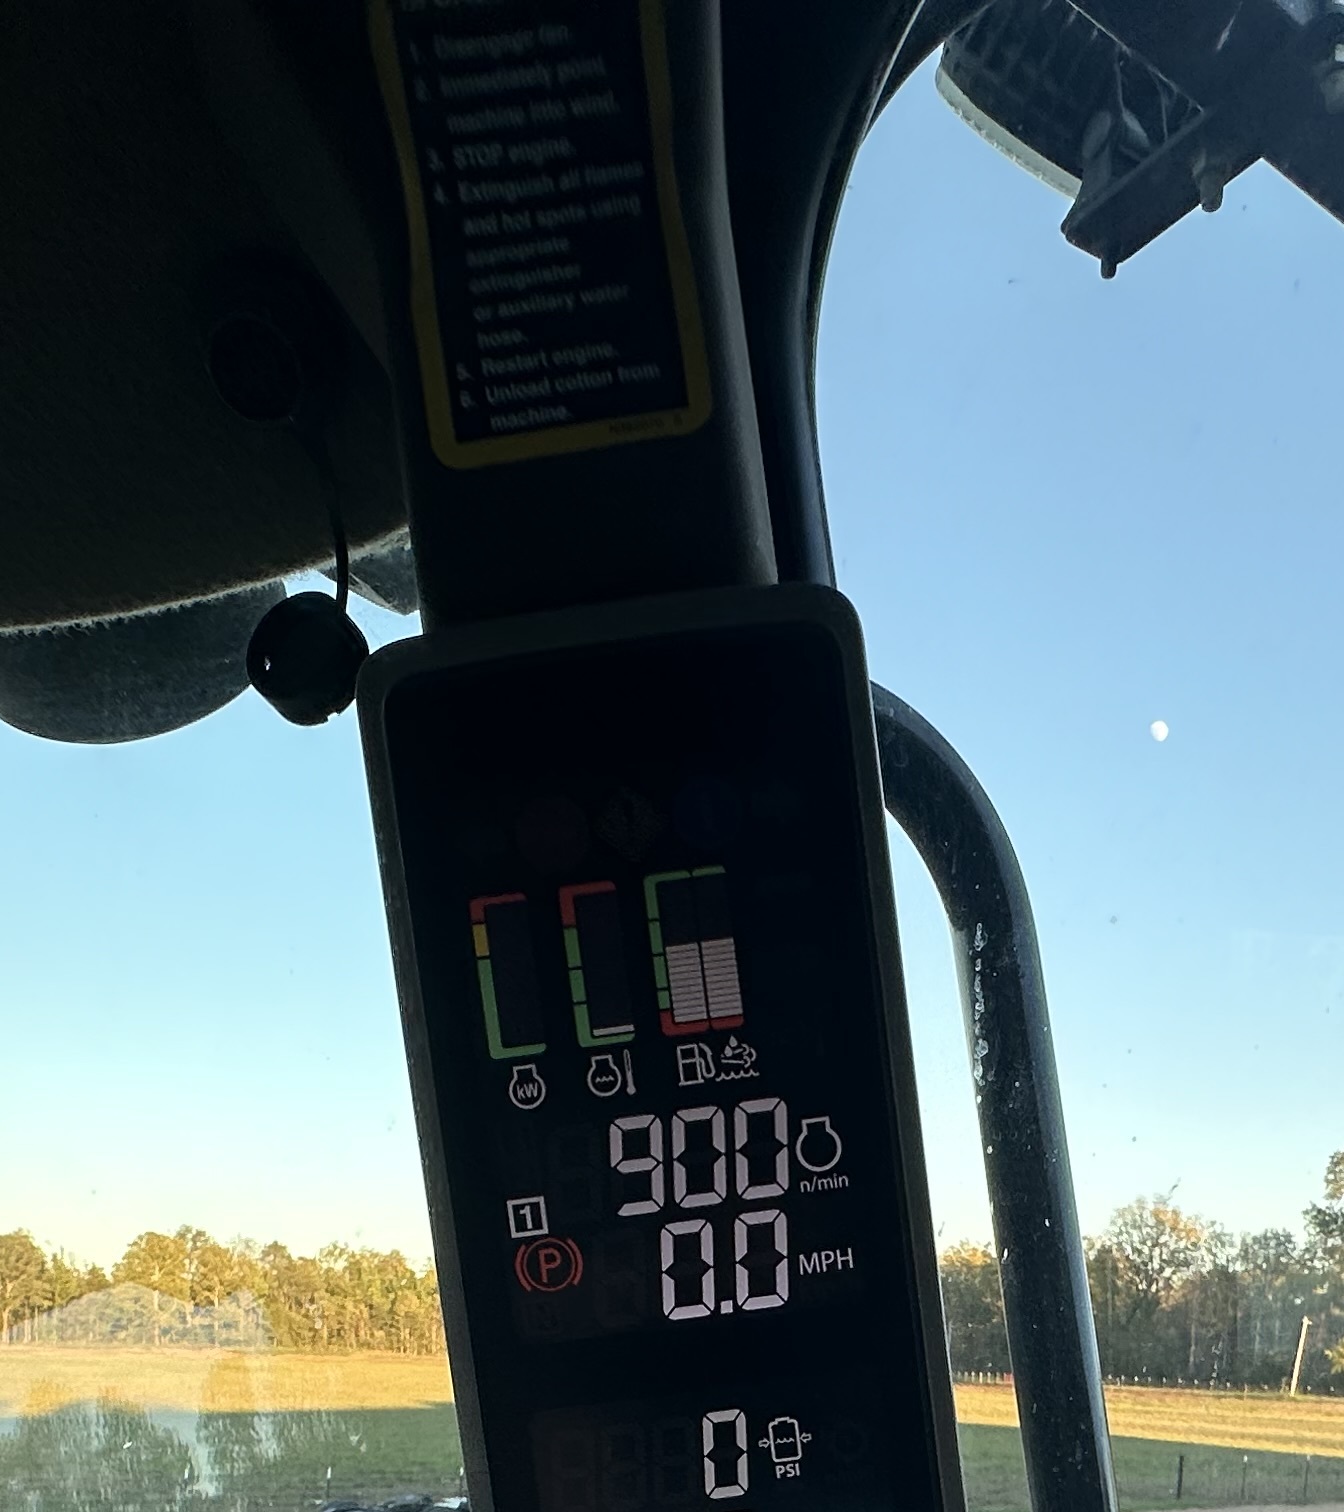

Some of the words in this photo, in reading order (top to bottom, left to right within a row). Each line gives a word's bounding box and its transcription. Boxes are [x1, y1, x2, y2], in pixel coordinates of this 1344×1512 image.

[452, 141, 503, 170] STOP
[480, 348, 549, 377] Restart
[484, 376, 551, 405] Unload
[554, 370, 613, 393] cotton
[617, 363, 661, 383] from
[609, 1097, 789, 1216] 900
[799, 1173, 850, 1194] n/min
[660, 1209, 789, 1321] 0.0
[798, 1249, 854, 1276] MPH
[702, 1408, 749, 1500] 0
[774, 1462, 801, 1478] PSI
